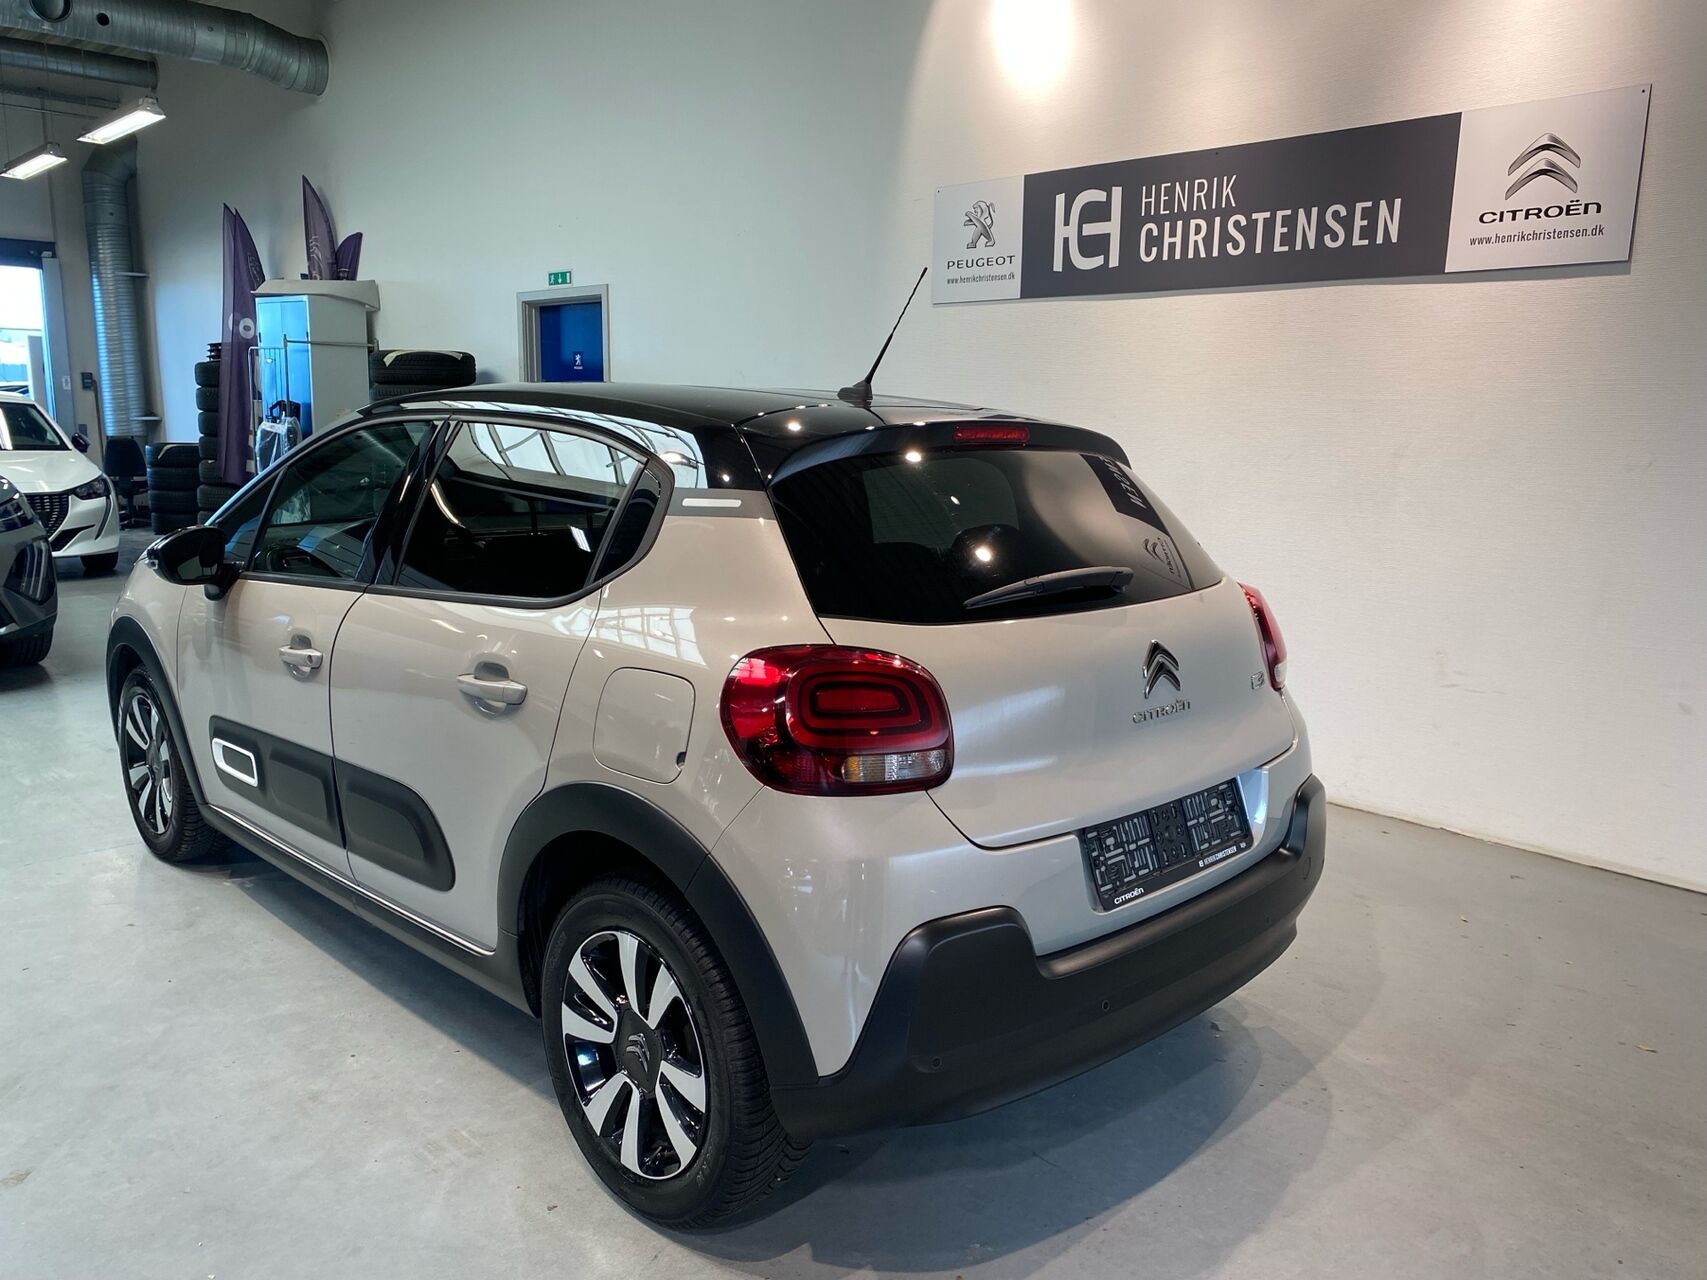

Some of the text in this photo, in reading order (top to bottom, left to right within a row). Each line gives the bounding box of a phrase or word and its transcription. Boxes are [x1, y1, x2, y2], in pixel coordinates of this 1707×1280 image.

[1141, 174, 1237, 217] HENRIK
[1139, 198, 1402, 263] CHRISTENSEN
[1469, 224, 1606, 246] www.henrikchristensen.dk
[947, 255, 1016, 270] PEUGEOT
